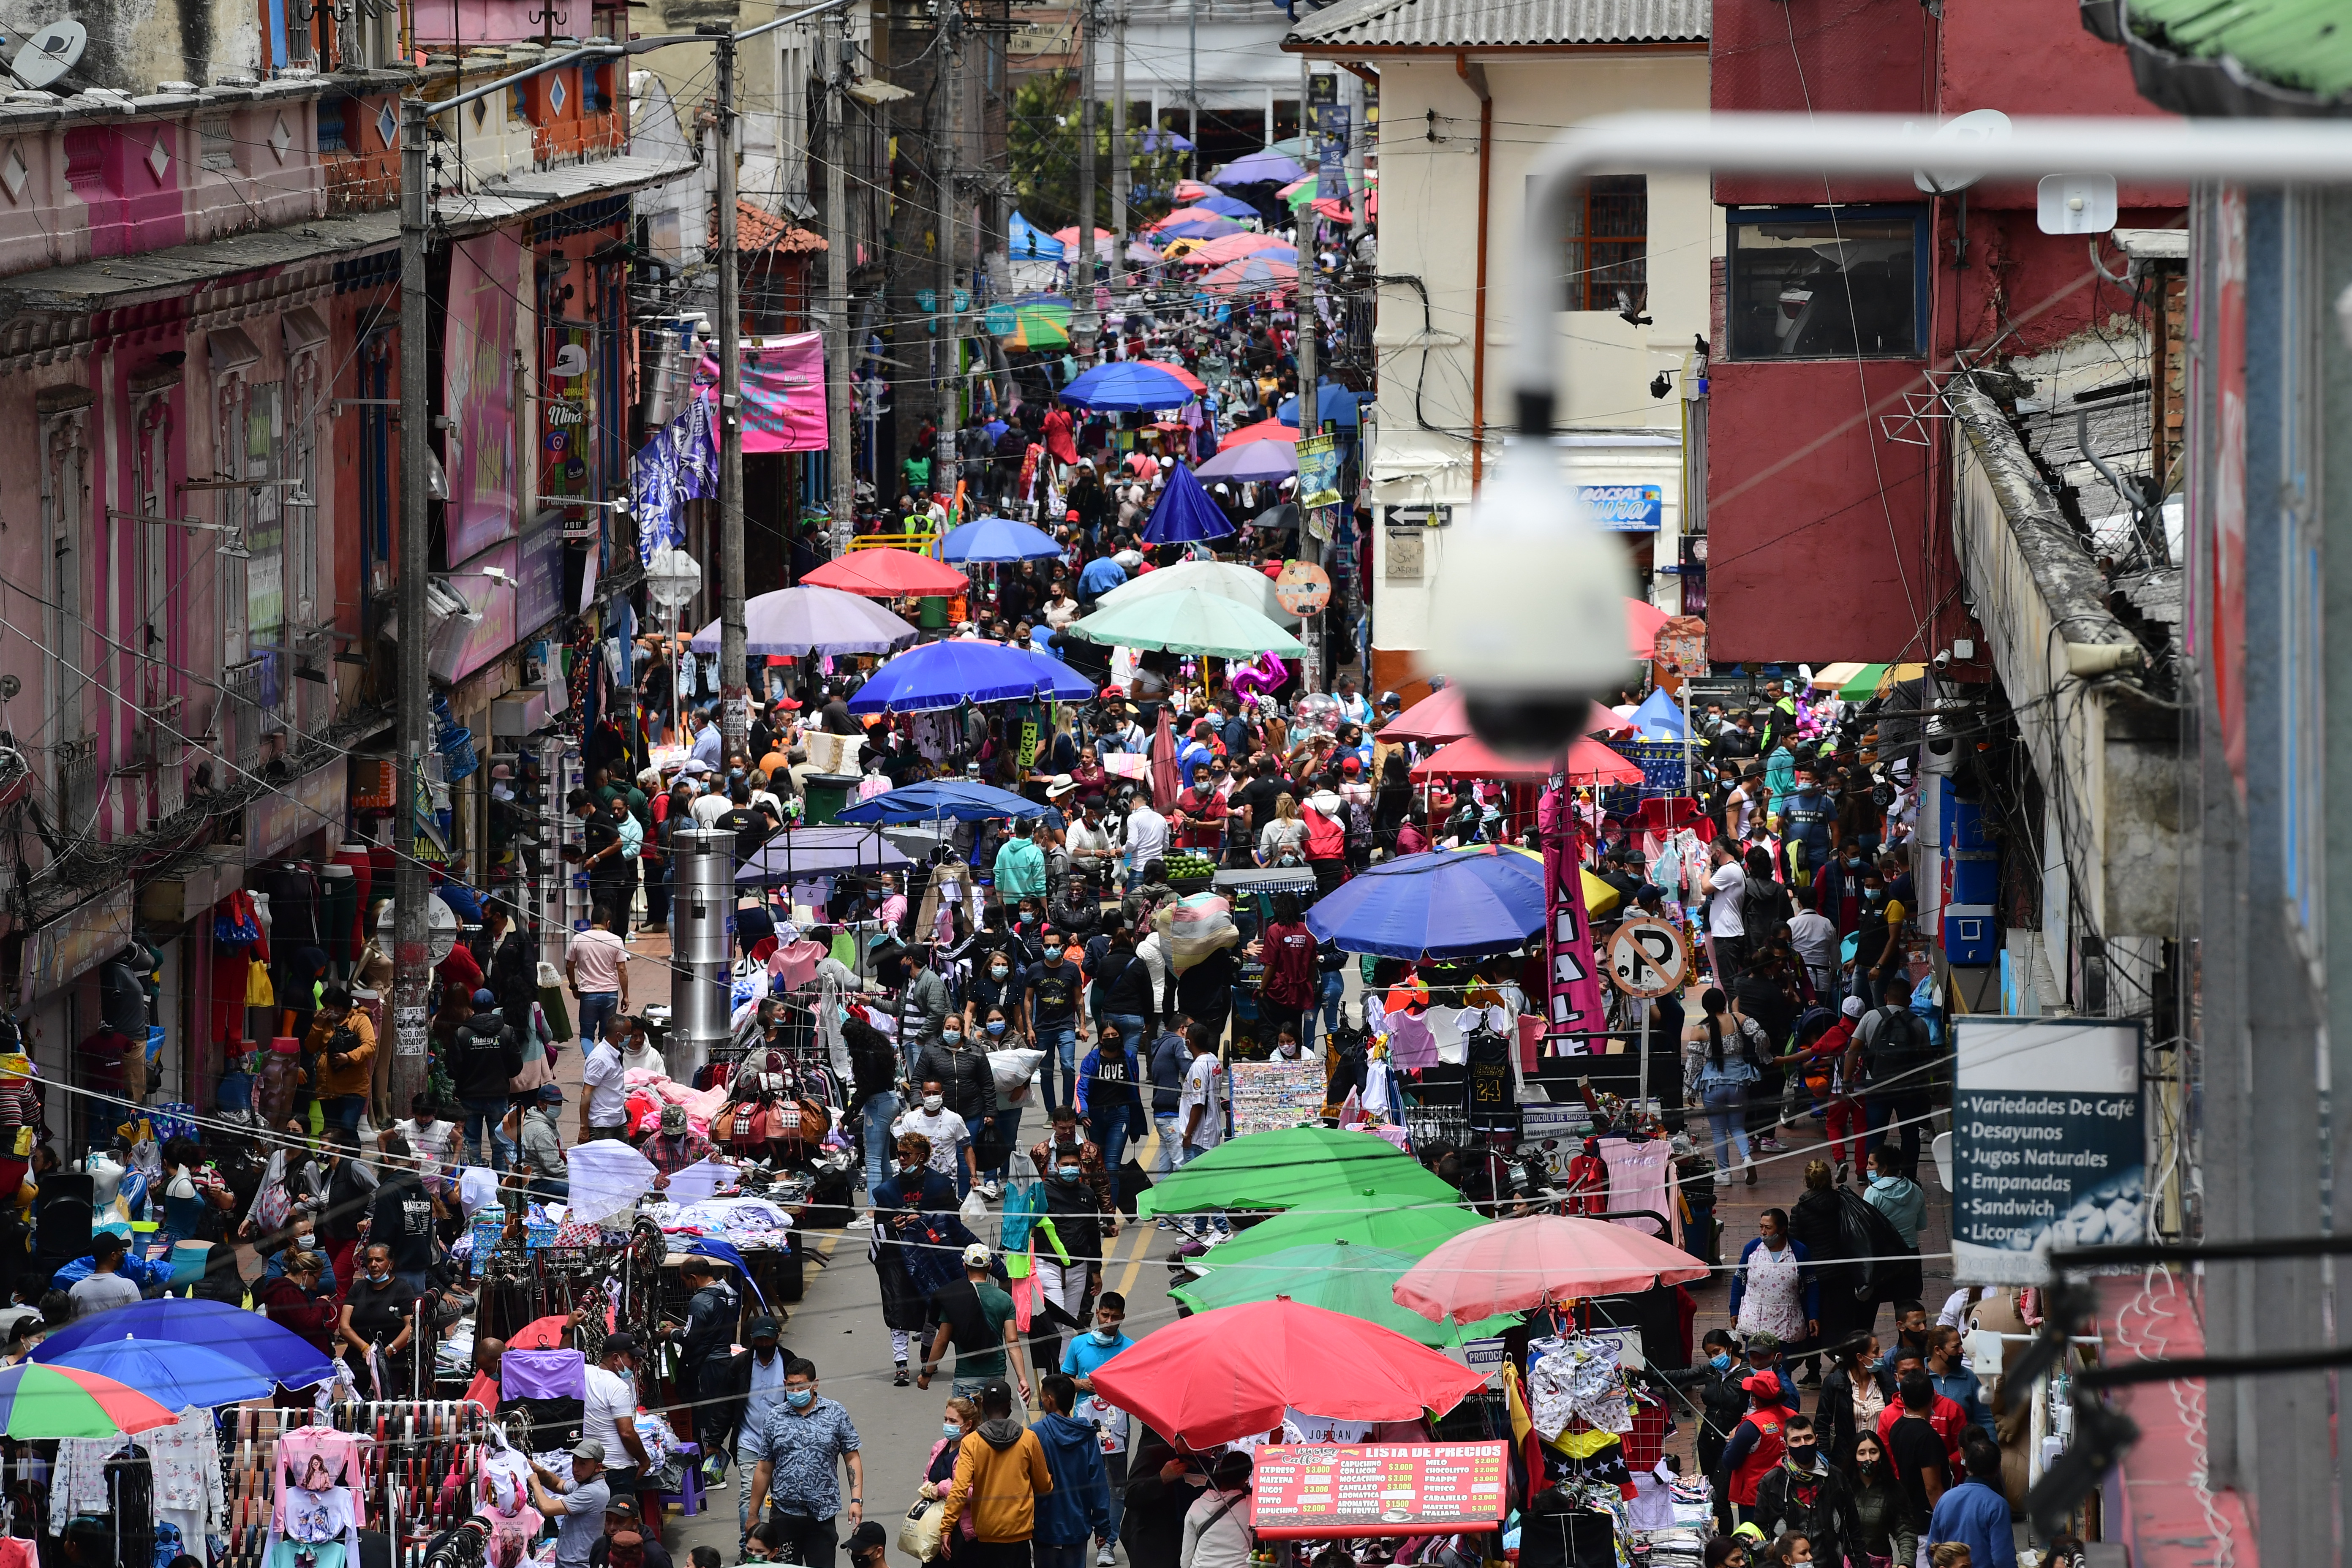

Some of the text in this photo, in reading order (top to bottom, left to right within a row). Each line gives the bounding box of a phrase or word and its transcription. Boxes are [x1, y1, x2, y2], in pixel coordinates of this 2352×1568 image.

[564, 388, 585, 397] GORRAS
[548, 405, 583, 426] Mina
[741, 404, 773, 416] POR
[742, 419, 784, 432] AYOR
[546, 494, 585, 506] PUBLICIDAD
[1022, 725, 1035, 764] MINUTOS
[1039, 978, 1065, 988] UNBEATABLE
[472, 1037, 494, 1045] Shaday
[1099, 1064, 1124, 1080] LOVE
[1473, 1063, 1505, 1078] LAKERS
[1476, 1080, 1501, 1101] 24
[1971, 1097, 2134, 1119] Variedades De Café
[1557, 1113, 1565, 1122] DE
[1972, 1122, 2063, 1142] Desayunos
[1970, 1148, 2108, 1170] Jugos Naturales
[1971, 1173, 2071, 1194] Empanadas
[1971, 1198, 2055, 1216] Sandwich
[1971, 1224, 2032, 1241] Licores
[1469, 1350, 1503, 1362] PROTOCO
[1309, 1429, 1350, 1440] JORDAN
[1365, 1446, 1501, 1457] LISTA DE PRECIOS
[1340, 1459, 1382, 1467] CAPUCHINO
[1259, 1475, 1293, 1484] MAIZENA
[1339, 1474, 1386, 1482] MOCACHINO
[1258, 1485, 1283, 1493] JUGOS
[1258, 1496, 1282, 1504] TINTO
[1337, 1499, 1379, 1507] AROMATICA
[779, 1541, 794, 1553] ACK
